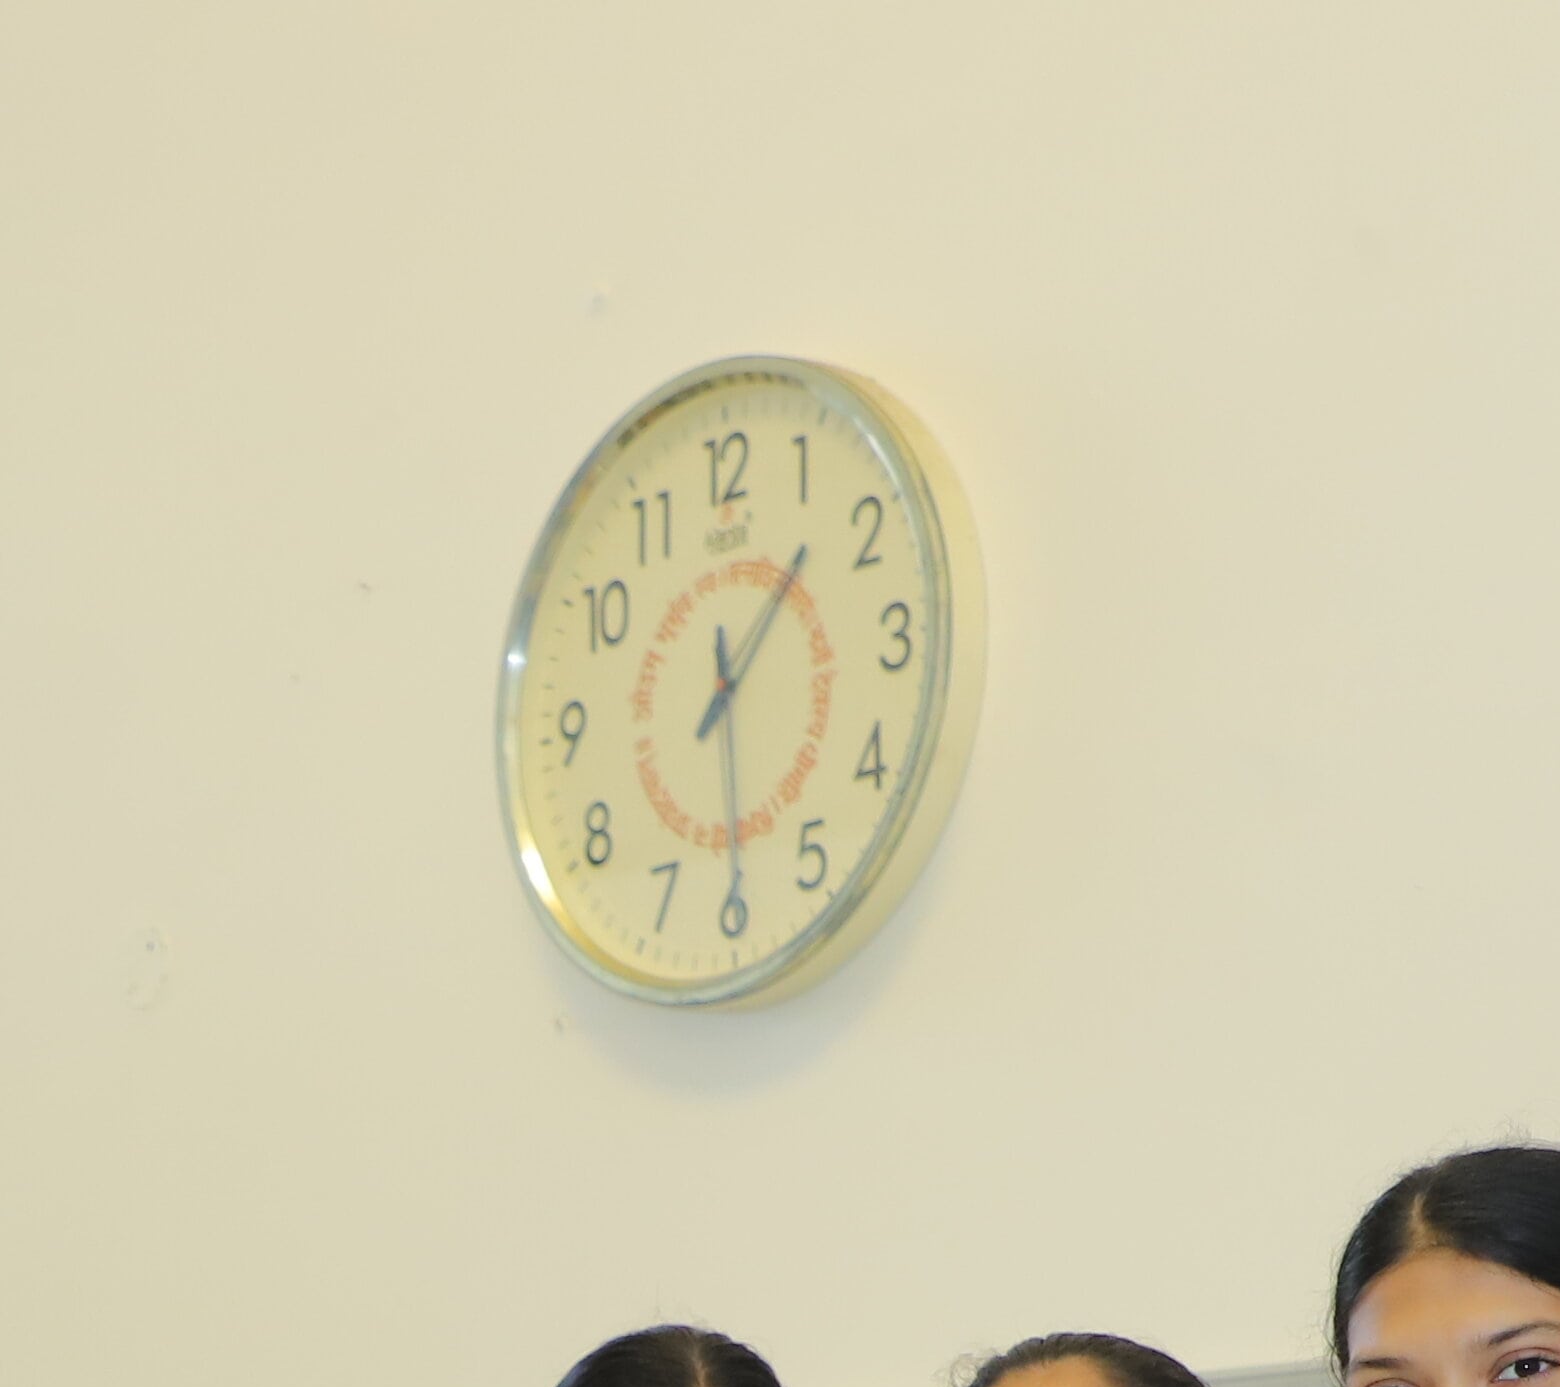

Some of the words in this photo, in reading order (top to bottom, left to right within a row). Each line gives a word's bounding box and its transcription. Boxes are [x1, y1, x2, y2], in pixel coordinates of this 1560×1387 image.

[704, 431, 750, 508] 12
[792, 434, 809, 505] 1
[632, 489, 672, 567] 11
[851, 495, 884, 570] 2
[583, 578, 630, 655] 10
[879, 601, 912, 672] 3
[559, 700, 588, 768] 9
[853, 719, 887, 791] 4
[585, 801, 613, 867] 8
[795, 818, 828, 892] 5
[649, 861, 682, 934] 7
[719, 867, 749, 938] 6
